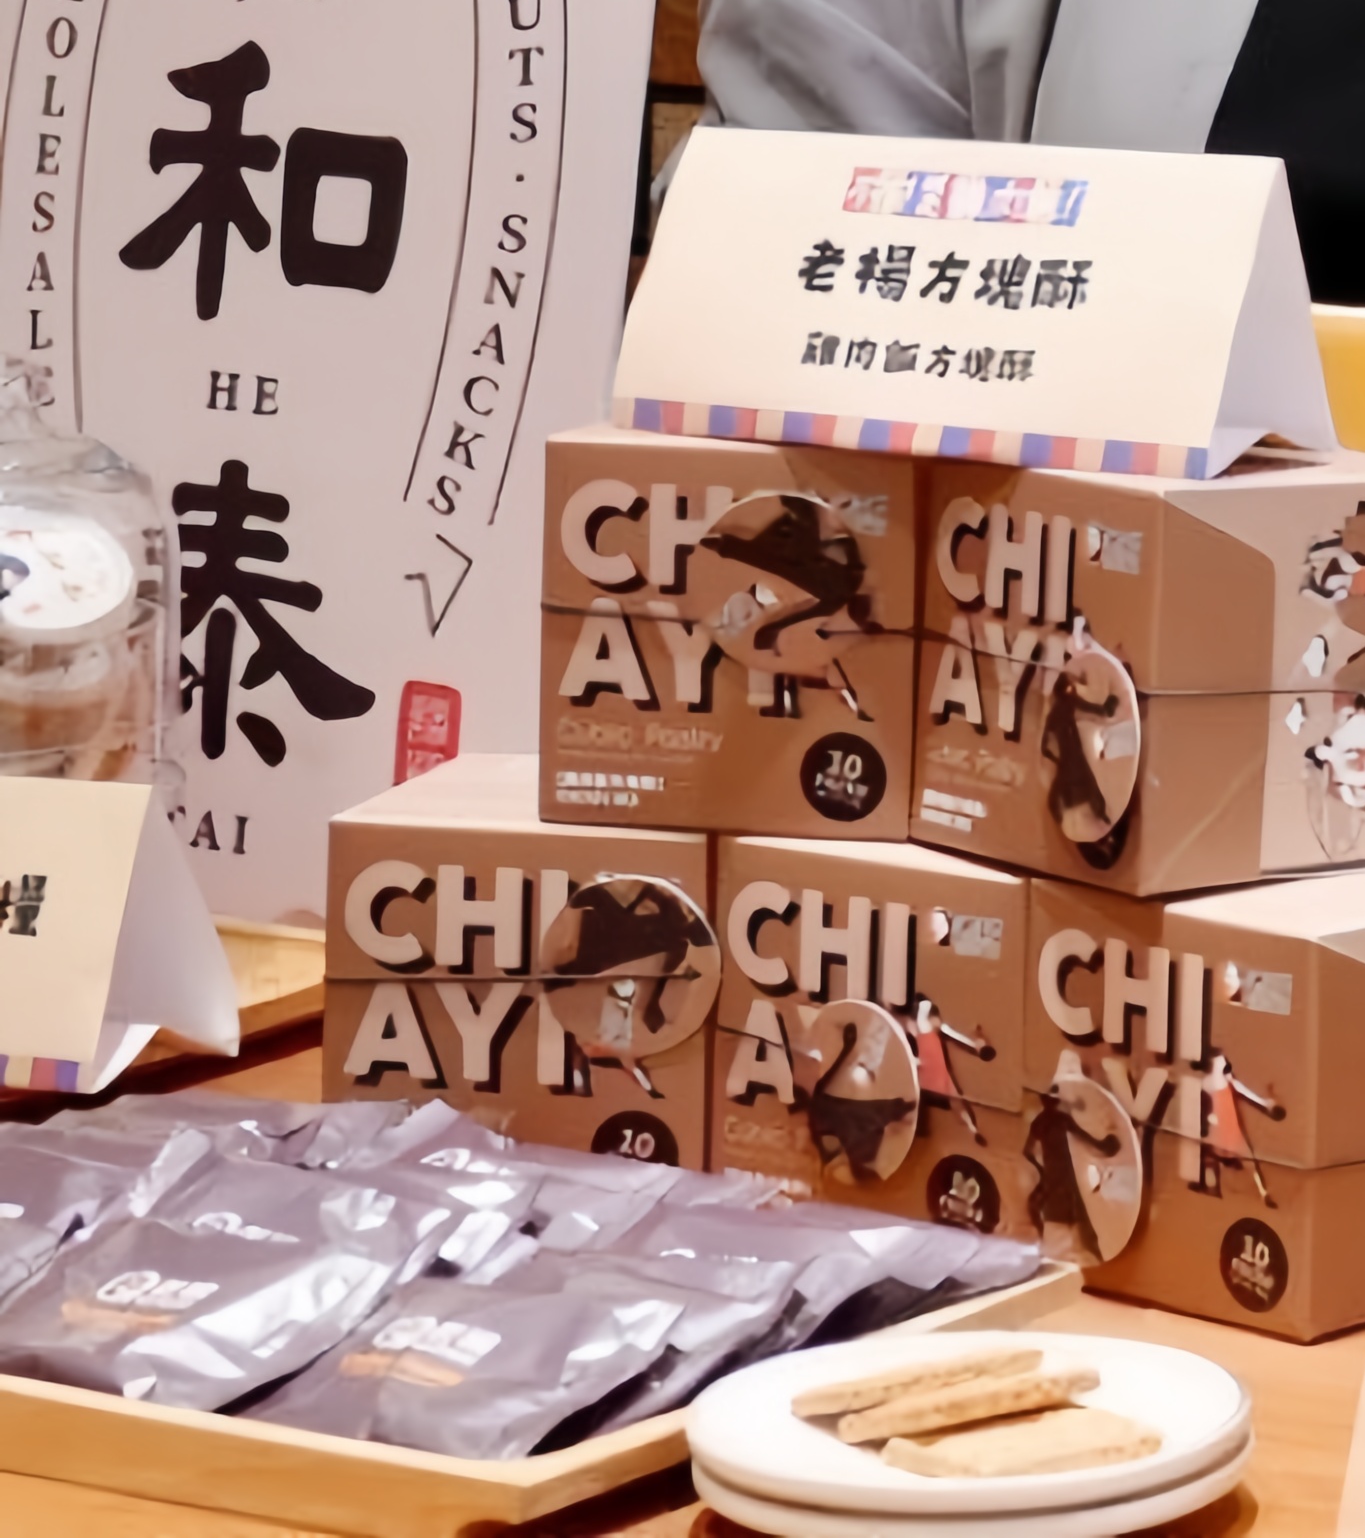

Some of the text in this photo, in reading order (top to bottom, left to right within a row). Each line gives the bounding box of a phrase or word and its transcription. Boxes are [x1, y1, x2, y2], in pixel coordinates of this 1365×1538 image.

[118, 40, 408, 321] 和
[798, 239, 1094, 311] 老楊方塊酥
[206, 371, 280, 415] HE
[427, 212, 529, 517] SNACKS
[560, 478, 735, 594] CH
[936, 495, 1075, 628] CHI
[172, 459, 376, 768] 泰
[727, 880, 916, 1012] CHI
[1038, 928, 1210, 1070] CHI
